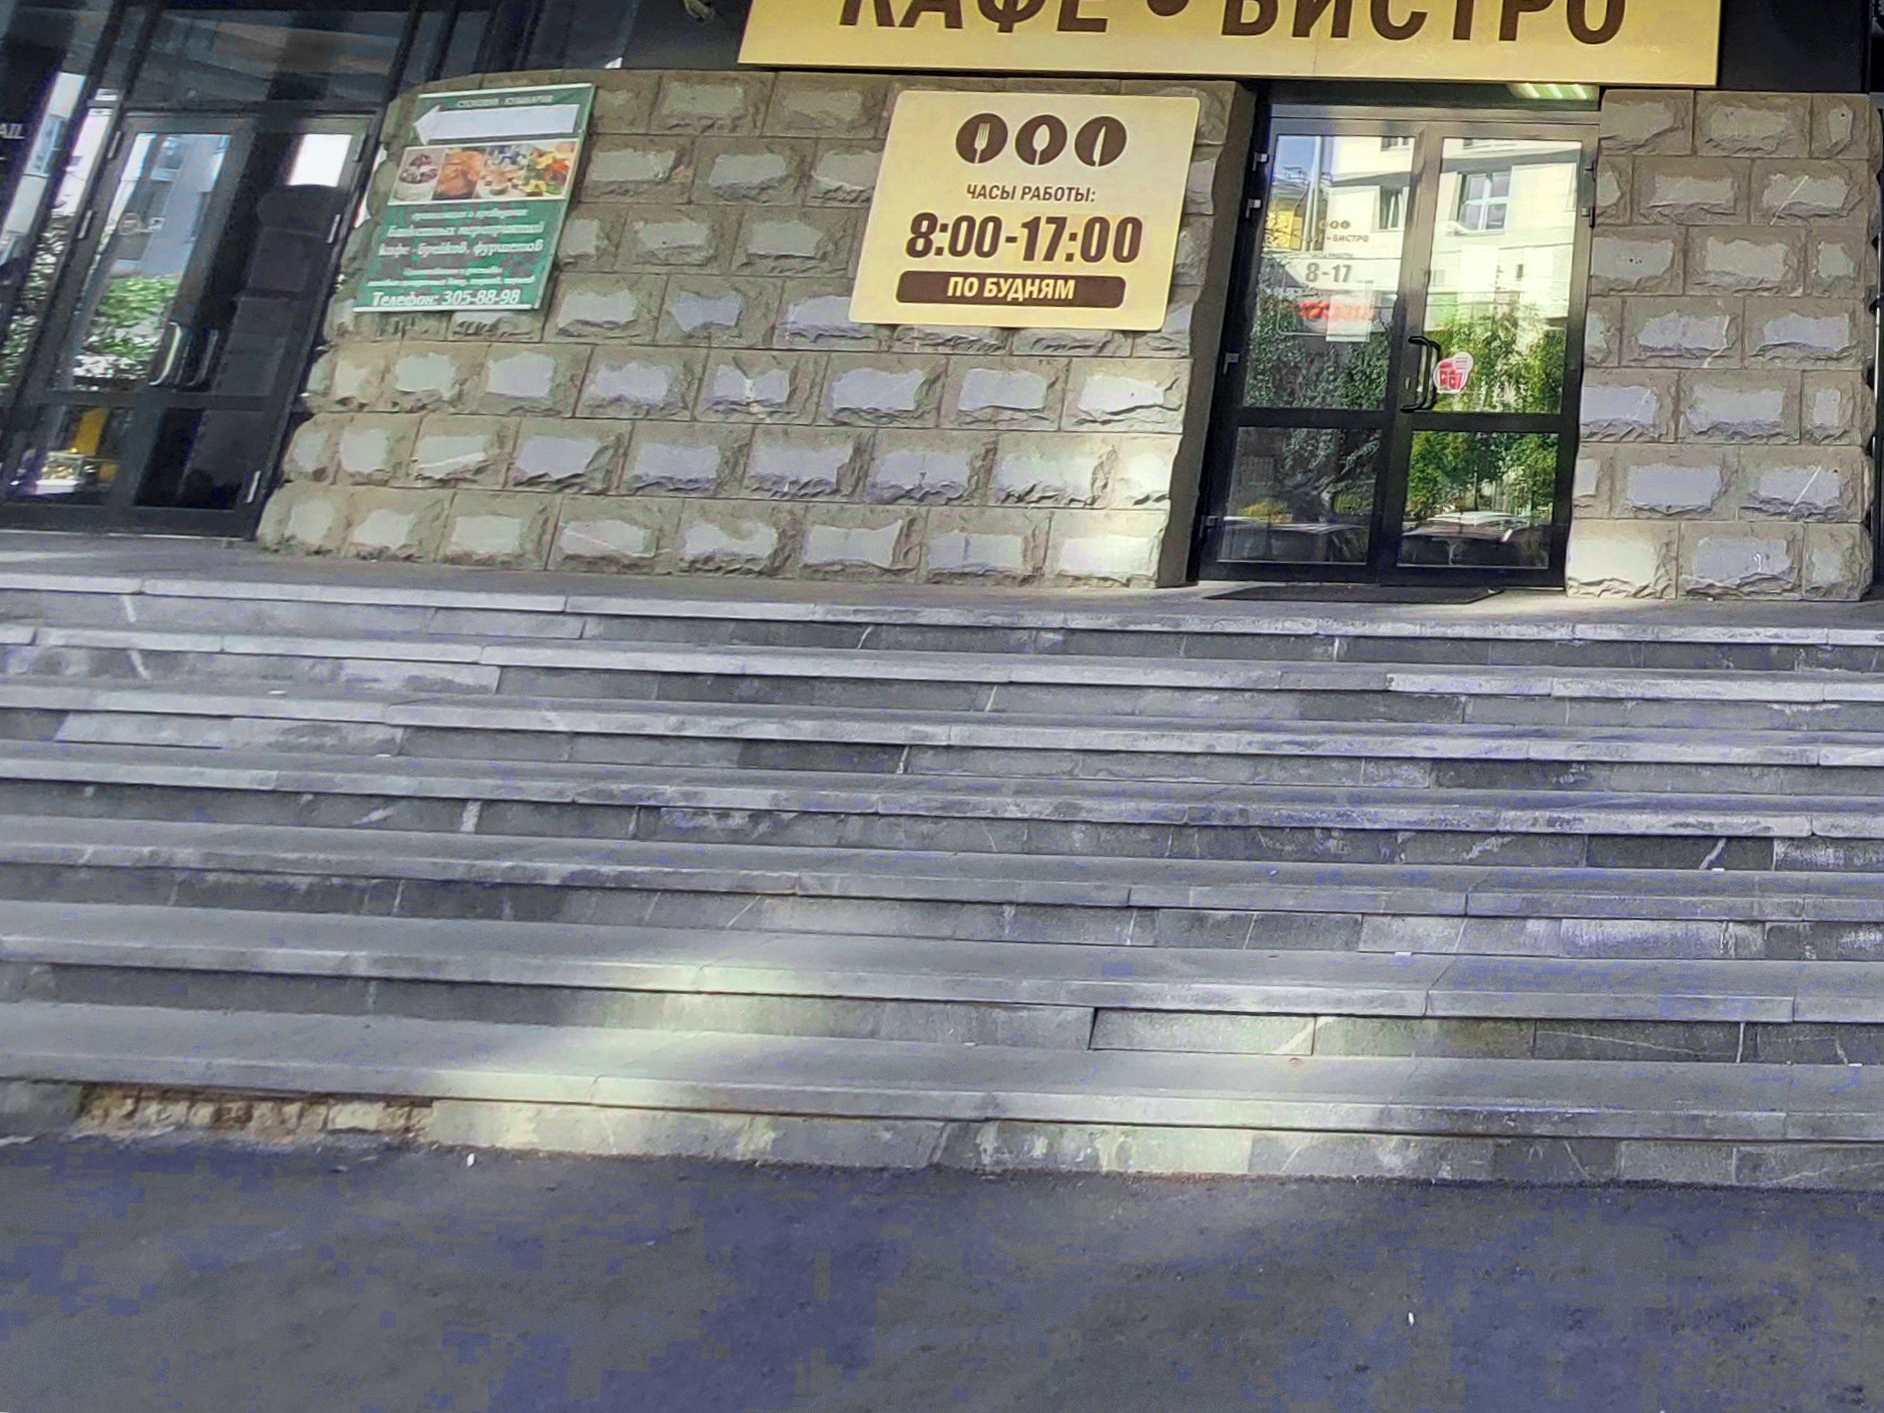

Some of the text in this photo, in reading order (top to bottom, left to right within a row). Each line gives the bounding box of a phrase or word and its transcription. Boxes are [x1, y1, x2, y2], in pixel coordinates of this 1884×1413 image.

[966, 184, 1096, 203] ЧАСЫ РАБОТЫ:
[441, 288, 521, 305] 305-88-98
[947, 276, 1077, 303] ПО БУДНЯМ
